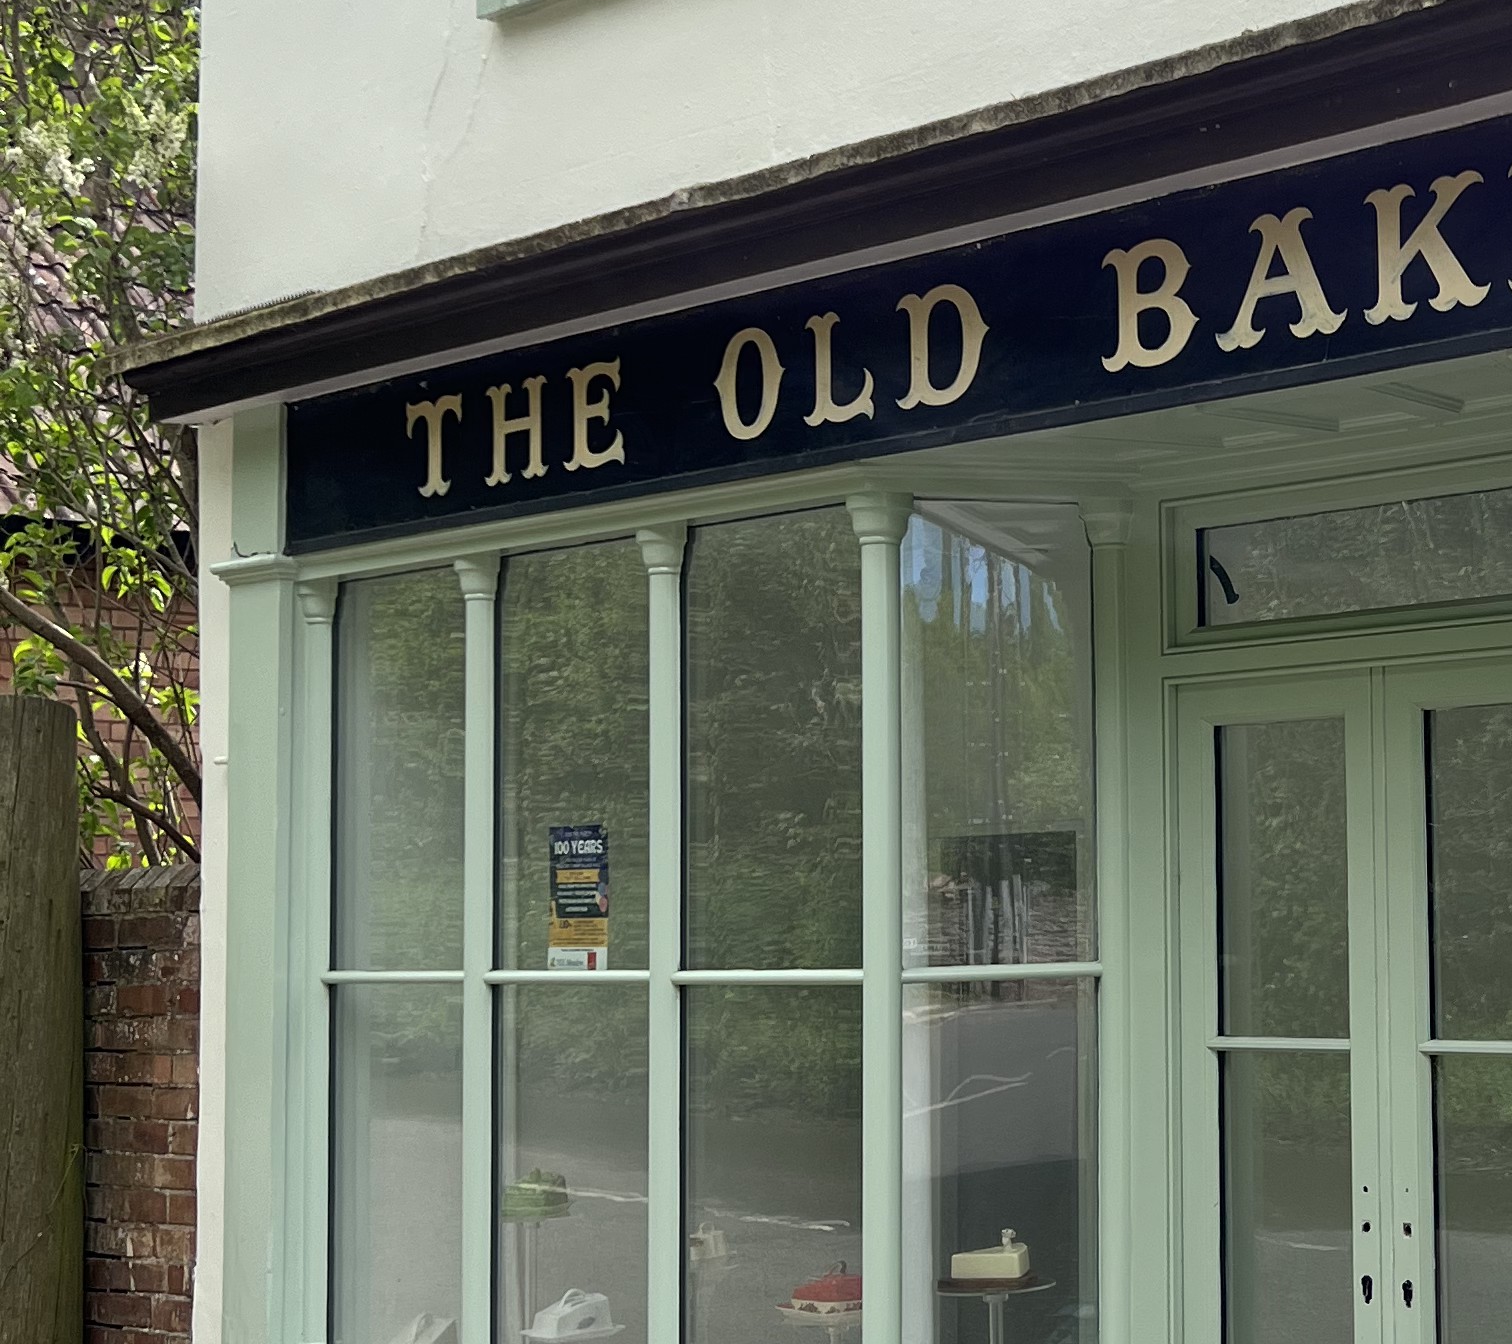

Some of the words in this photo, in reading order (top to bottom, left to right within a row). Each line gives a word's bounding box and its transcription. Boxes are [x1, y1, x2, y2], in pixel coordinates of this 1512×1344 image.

[405, 357, 626, 498] THE
[713, 283, 990, 441] OLD
[554, 840, 570, 855] 100
[570, 839, 603, 855] YEARS
